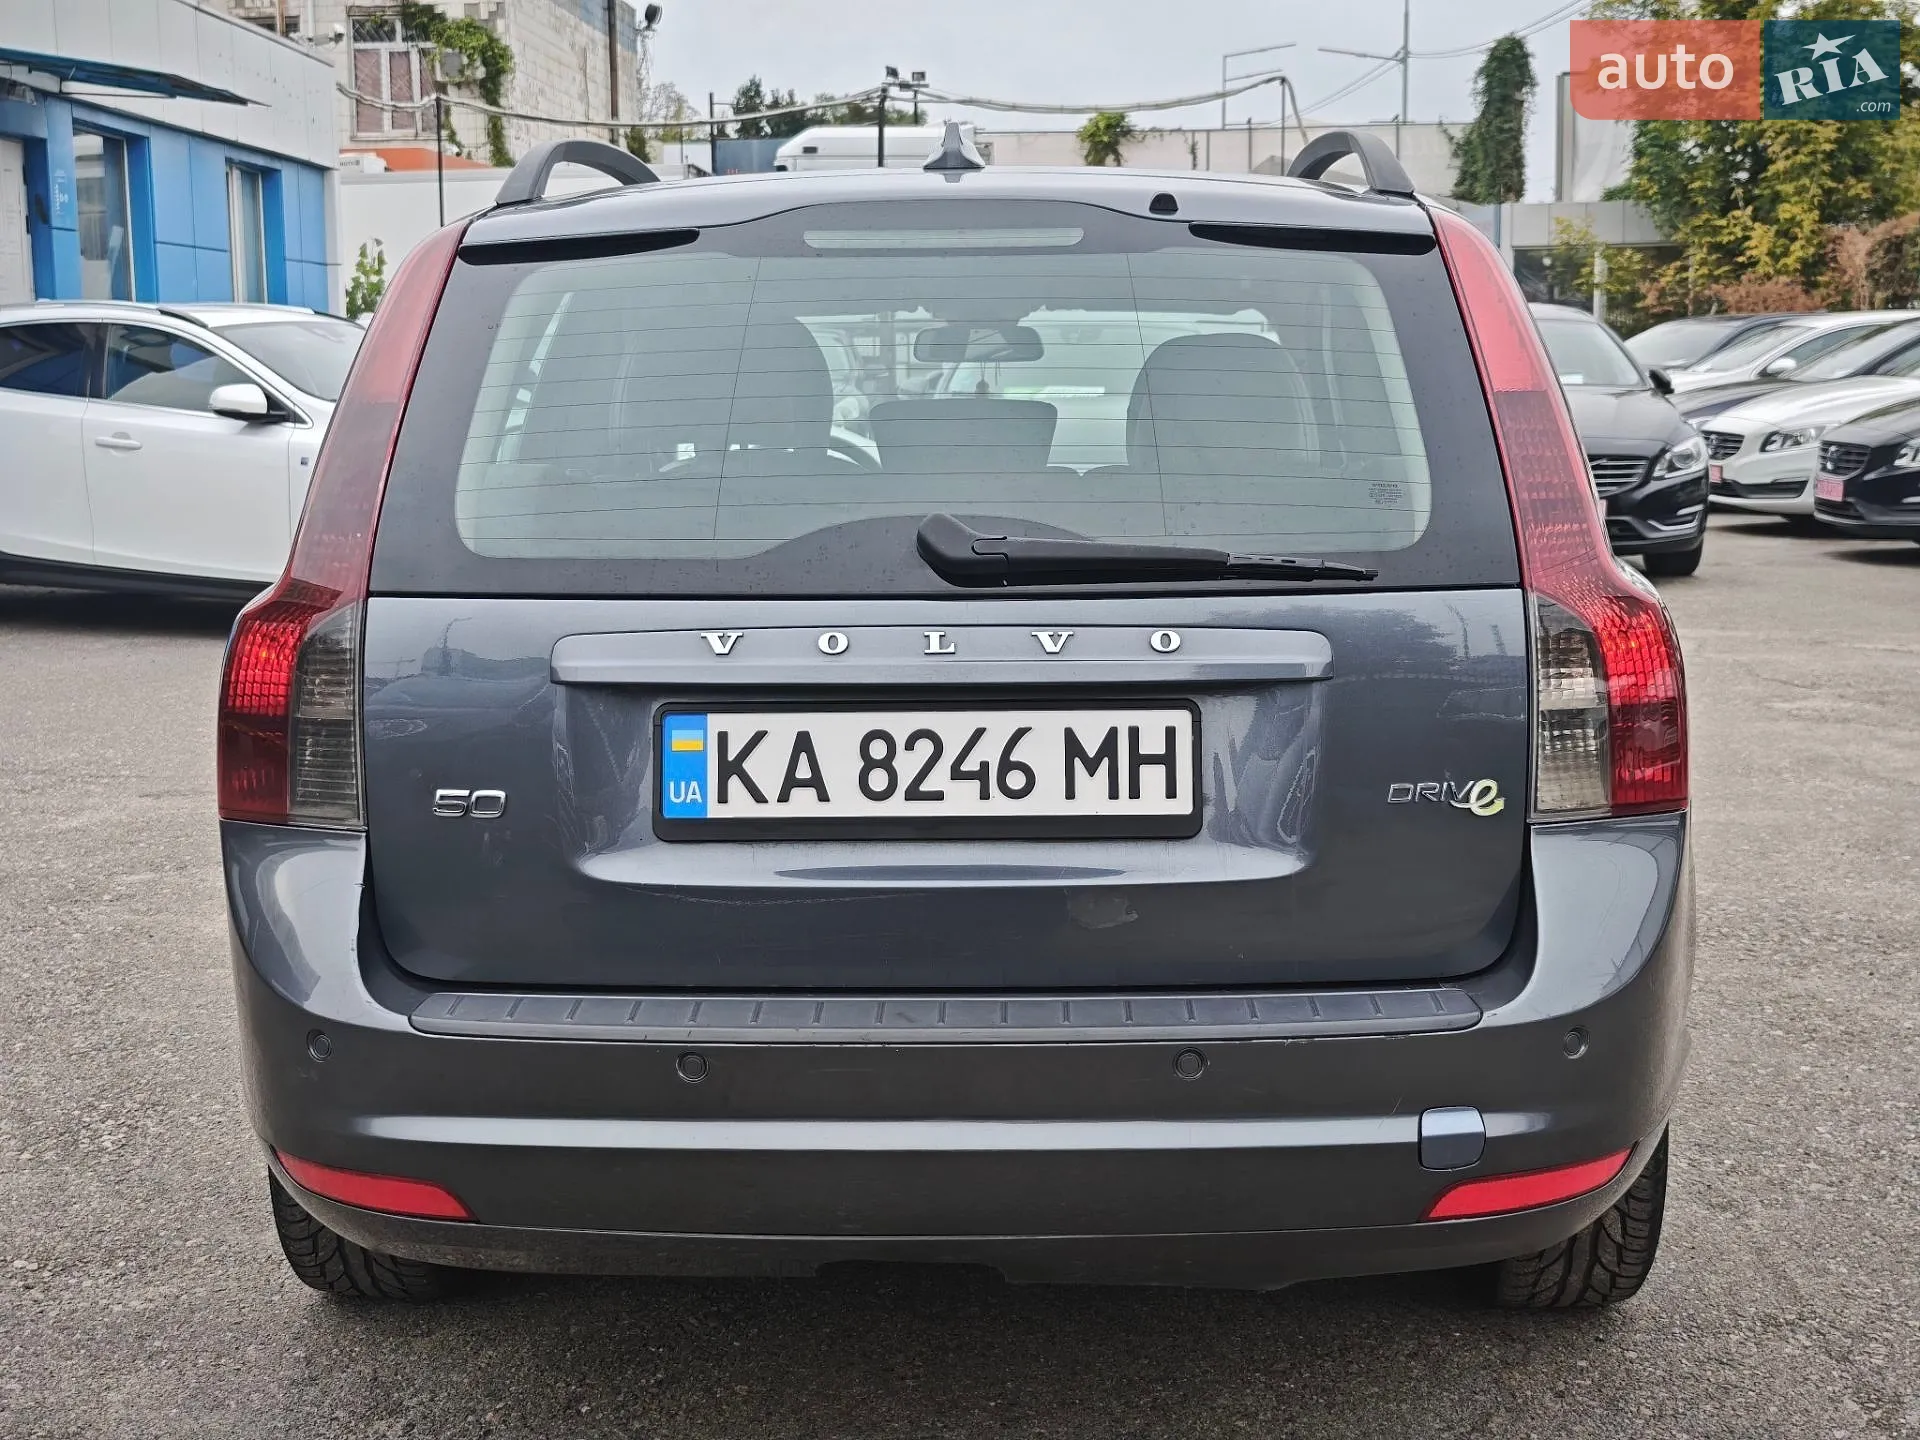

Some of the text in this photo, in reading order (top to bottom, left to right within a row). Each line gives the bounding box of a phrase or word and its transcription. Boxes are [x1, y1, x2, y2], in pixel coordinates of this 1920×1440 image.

[701, 630, 1181, 655] VOLVO
[717, 725, 1177, 804] KA 8246 MH
[433, 789, 506, 818] 50
[670, 780, 702, 804] UA
